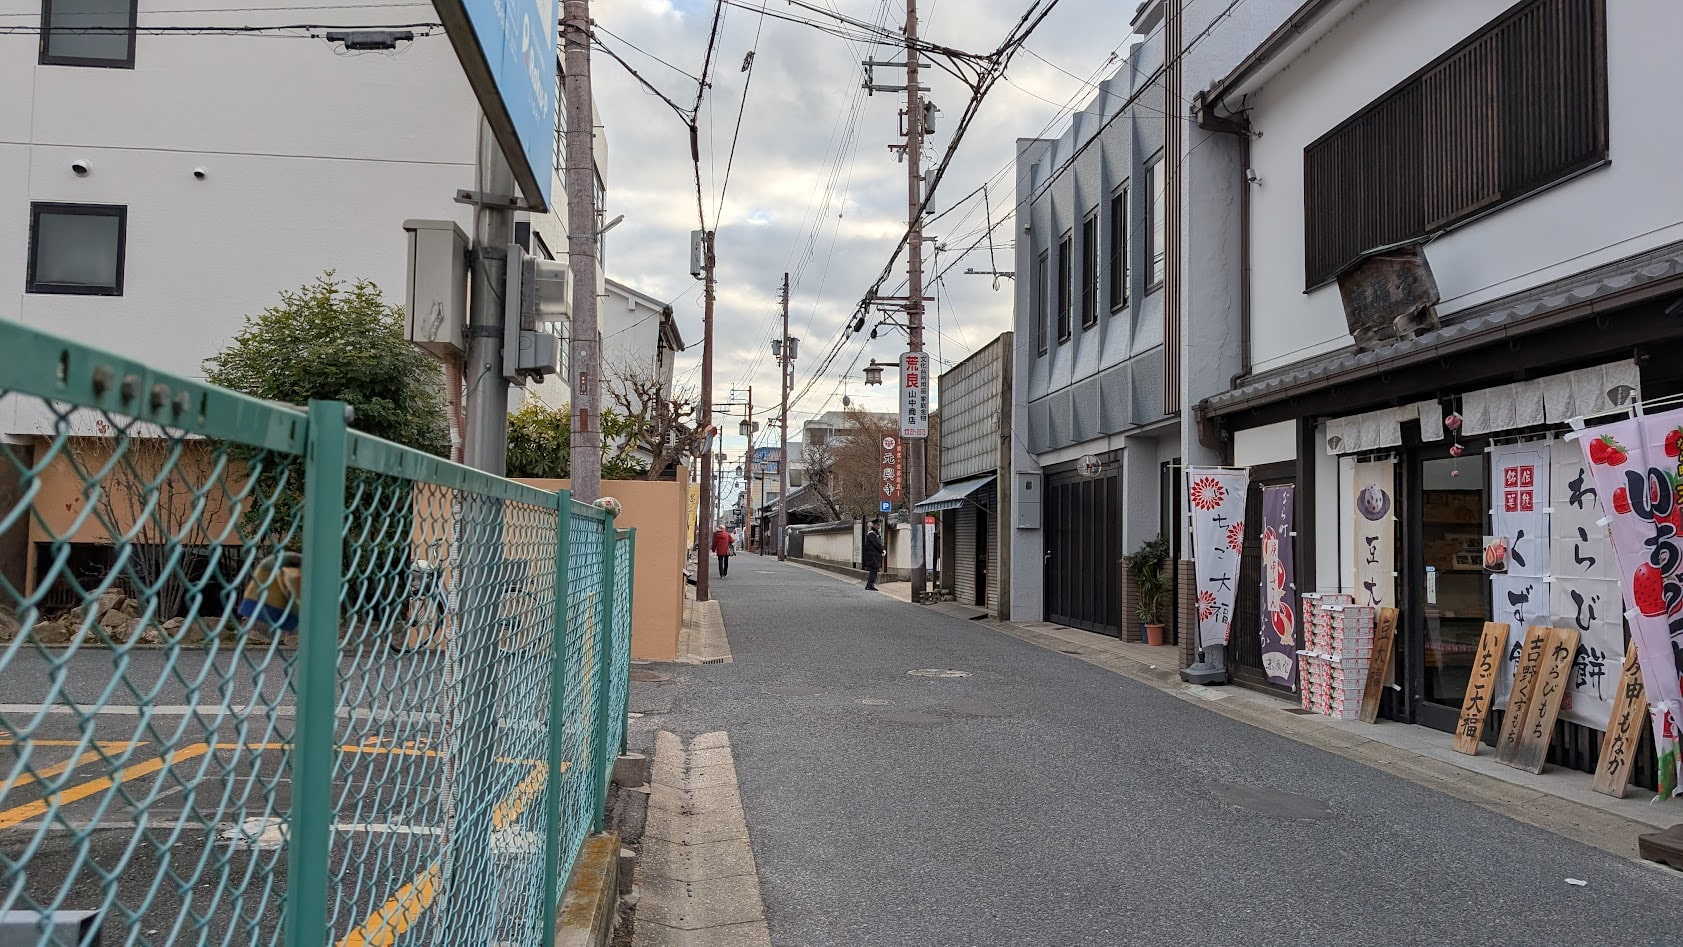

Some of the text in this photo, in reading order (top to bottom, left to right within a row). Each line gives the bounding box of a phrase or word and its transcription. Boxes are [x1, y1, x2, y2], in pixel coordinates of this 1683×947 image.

[882, 502, 890, 510] P
[1209, 487, 1232, 624] いちご大福
[1567, 467, 1606, 702] わらび餅
[1366, 619, 1390, 688] 豆大福
[1460, 632, 1498, 739] いちご大福
[1532, 641, 1570, 739] わらびもち
